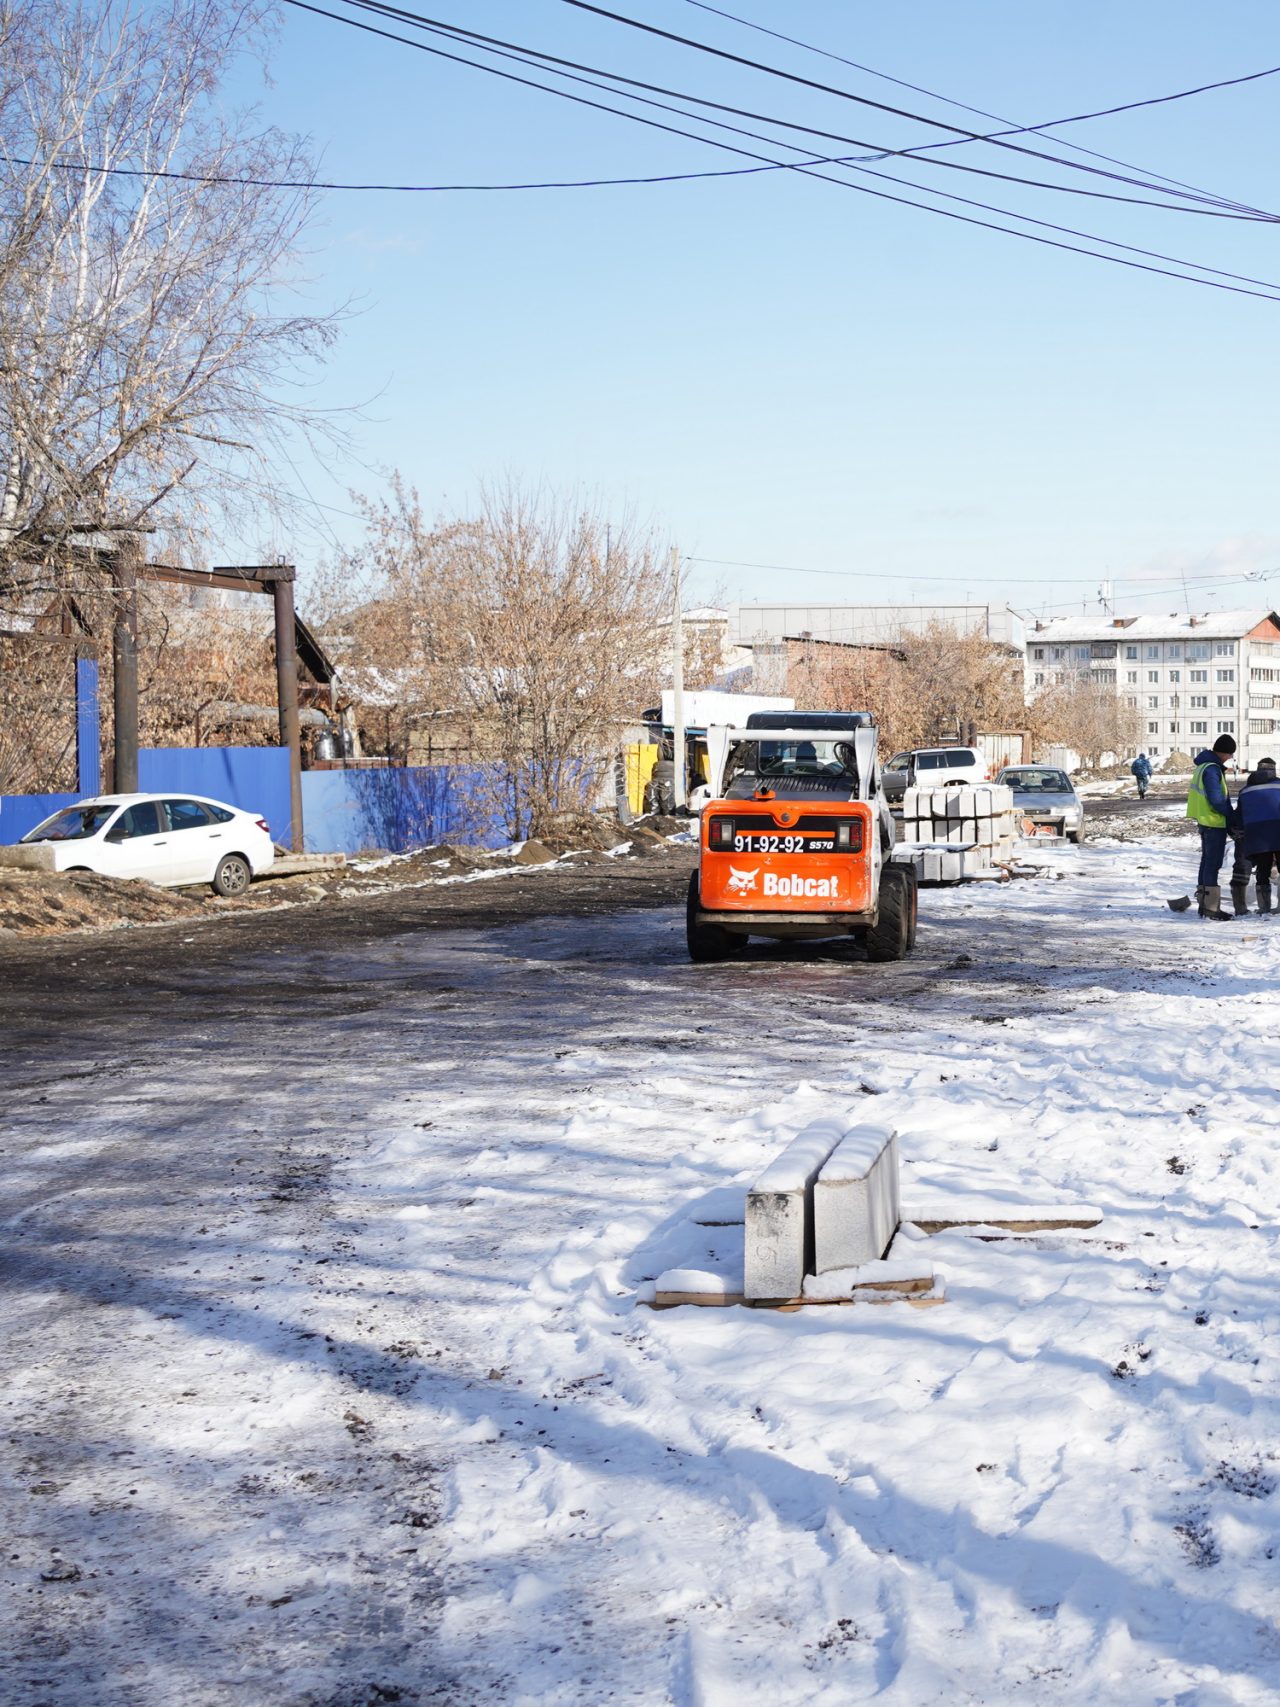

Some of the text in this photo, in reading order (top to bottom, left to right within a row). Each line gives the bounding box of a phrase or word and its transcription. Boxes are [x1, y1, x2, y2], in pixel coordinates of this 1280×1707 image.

[734, 835, 834, 853] 91-92-92 S570
[763, 872, 839, 898] Bobcat
